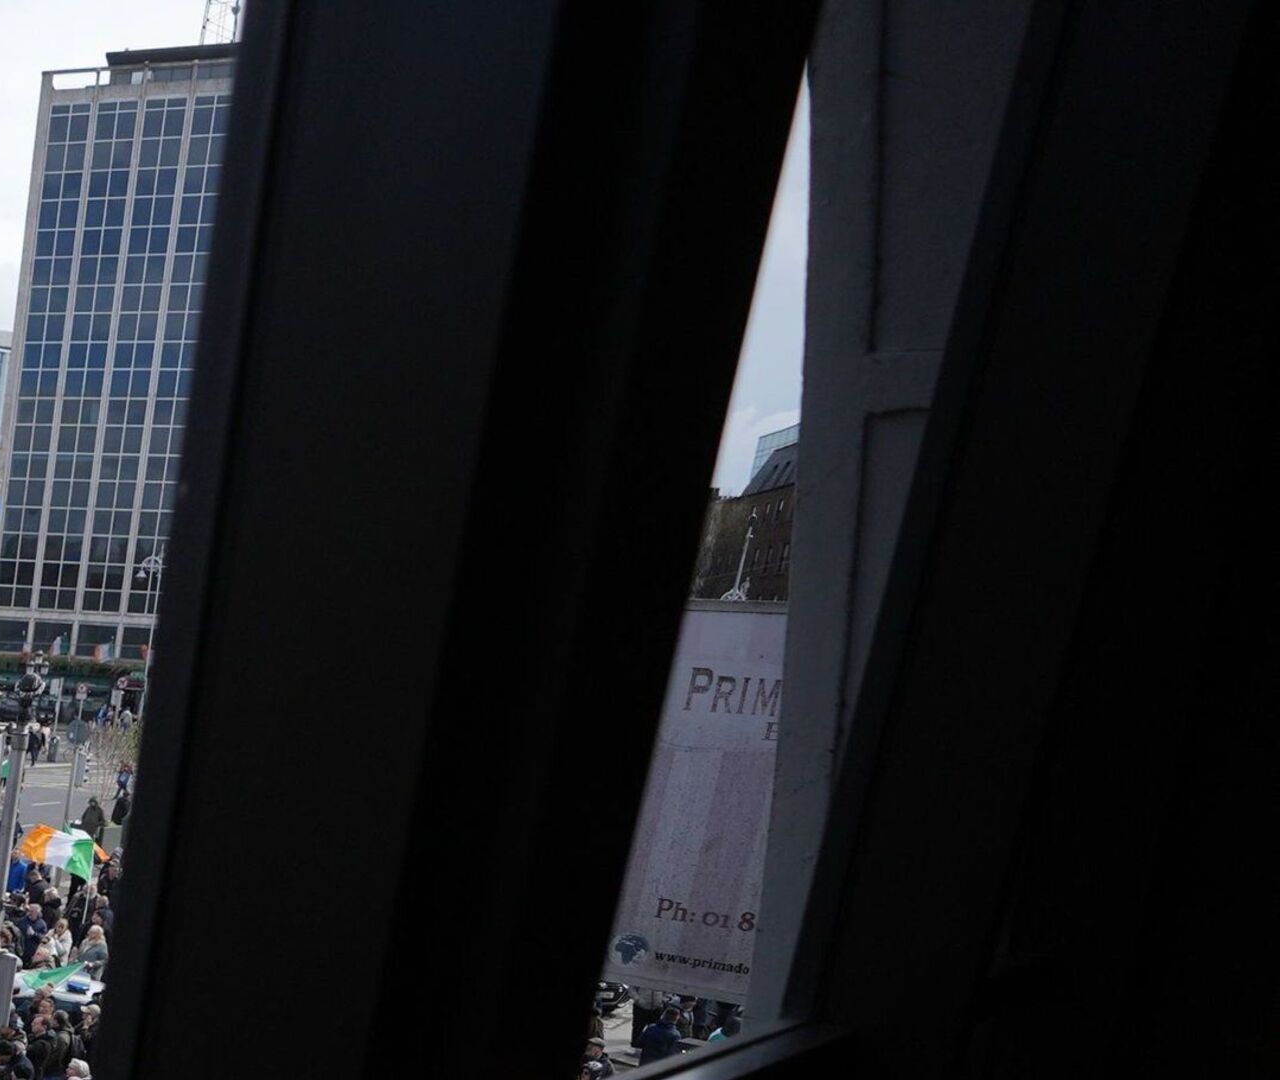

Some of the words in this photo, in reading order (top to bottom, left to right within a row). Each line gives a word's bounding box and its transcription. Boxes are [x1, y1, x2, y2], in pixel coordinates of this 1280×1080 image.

[682, 667, 782, 717] PRIM
[654, 898, 696, 923] Ph:
[702, 912, 729, 929] 01
[738, 912, 756, 932] 8
[654, 951, 750, 975] www.primado
